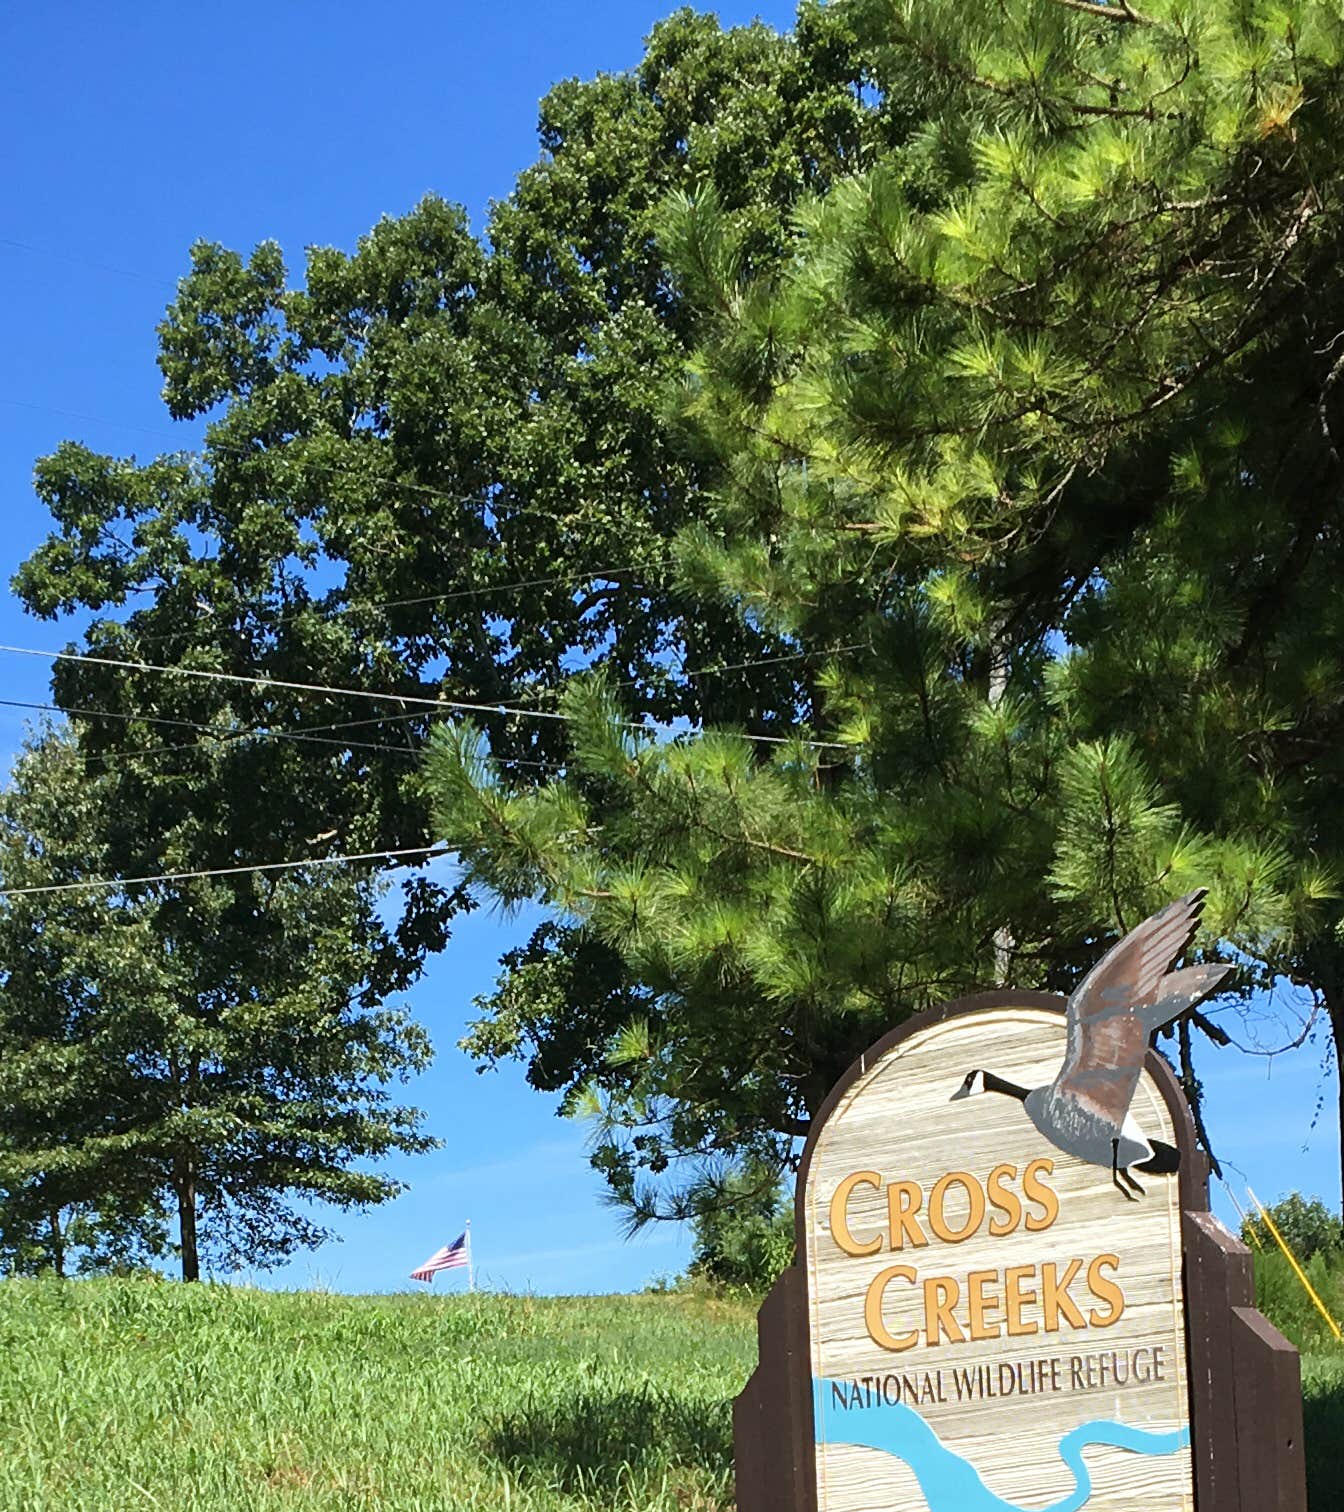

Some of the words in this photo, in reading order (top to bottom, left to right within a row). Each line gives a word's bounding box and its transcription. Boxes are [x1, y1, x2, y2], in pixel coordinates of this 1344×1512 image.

[829, 1158, 1059, 1257] CROSS
[864, 1253, 1125, 1352] CREEKS
[831, 1373, 947, 1411] NATIONAL
[953, 1358, 1061, 1401] WILDLIFE
[1070, 1346, 1165, 1389] REFUGE
